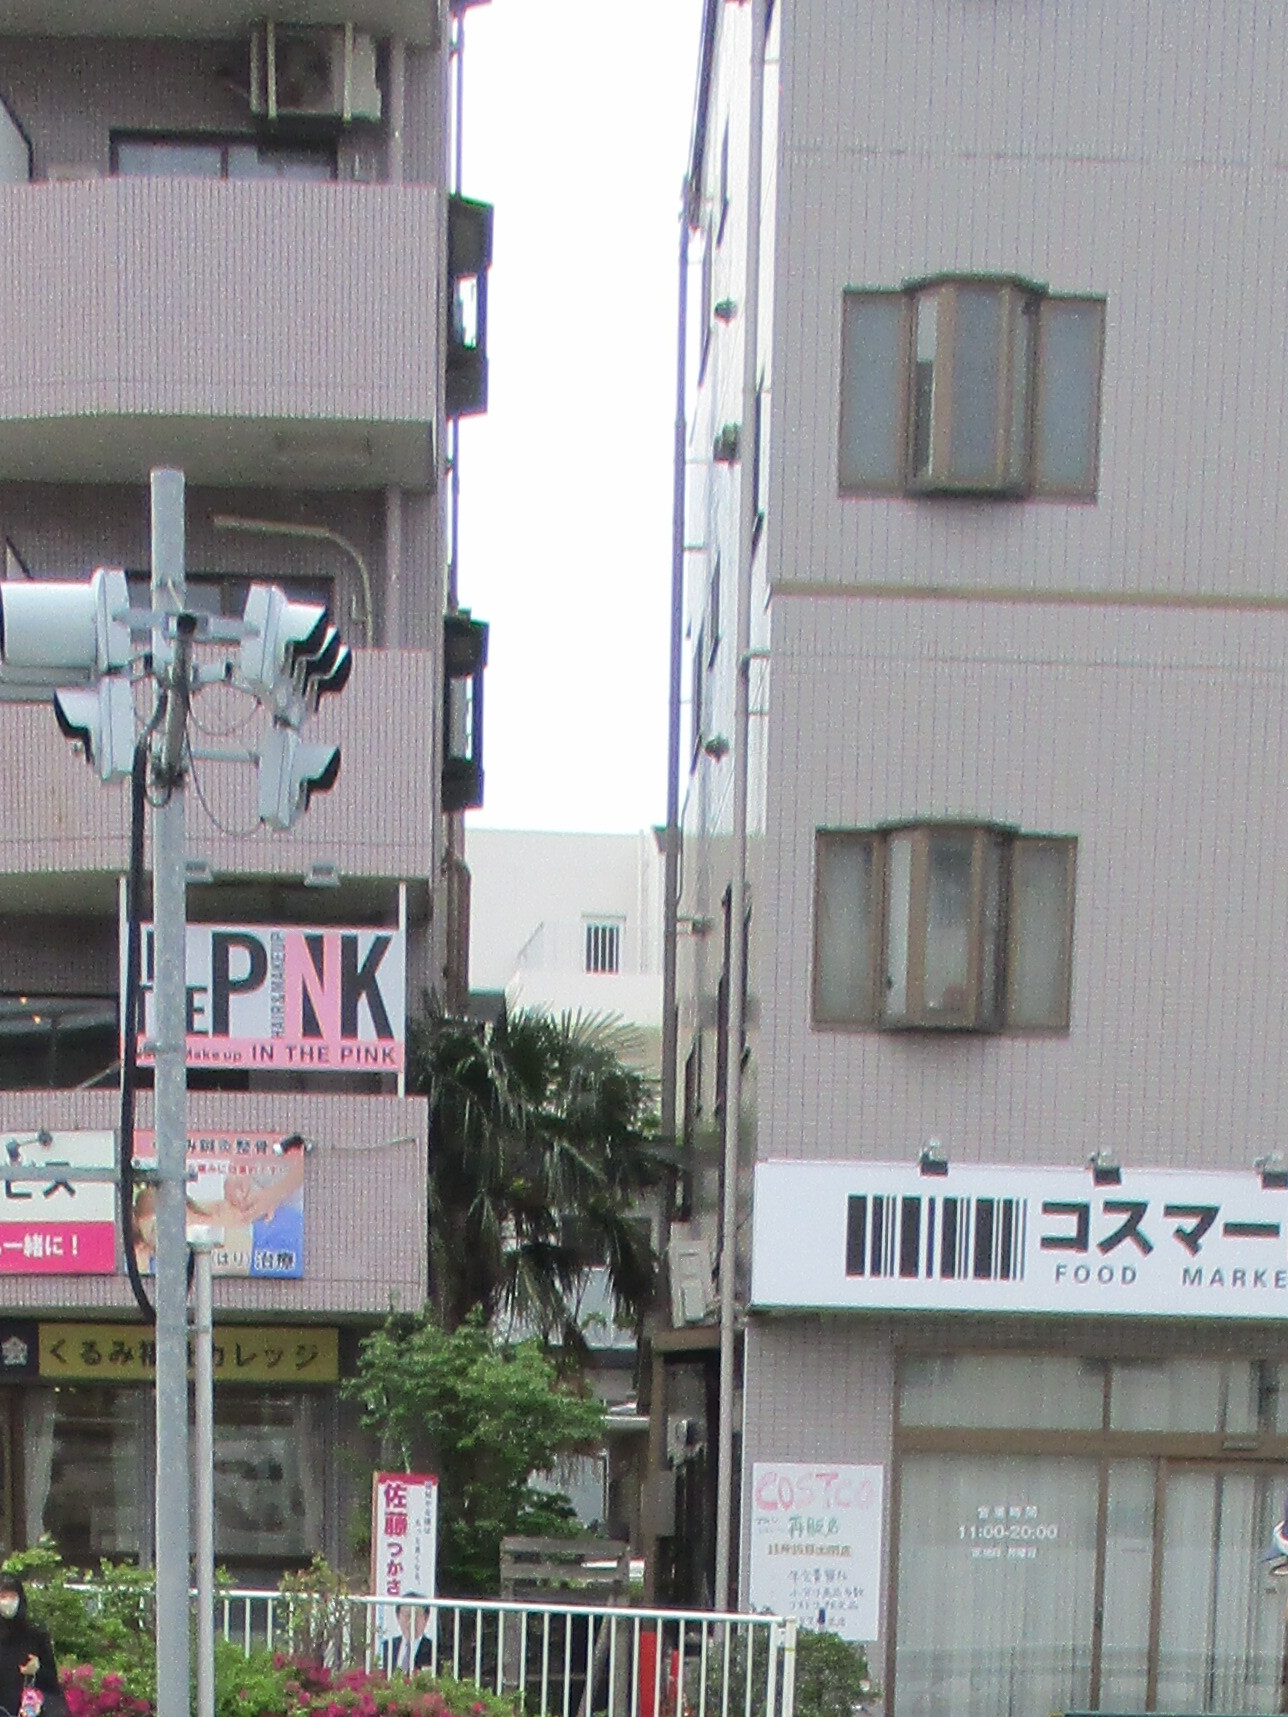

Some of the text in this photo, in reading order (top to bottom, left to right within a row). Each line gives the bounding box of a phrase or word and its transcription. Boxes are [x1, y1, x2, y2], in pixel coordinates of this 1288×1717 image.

[252, 1045, 275, 1062] IN
[286, 1046, 330, 1063] THE
[341, 1046, 397, 1064] PINK
[1055, 1264, 1138, 1285] FOOD
[755, 1471, 875, 1511] COSTCO
[383, 1482, 408, 1596] 佐藤つかさ
[958, 1524, 1058, 1540] 11:00-20:00
